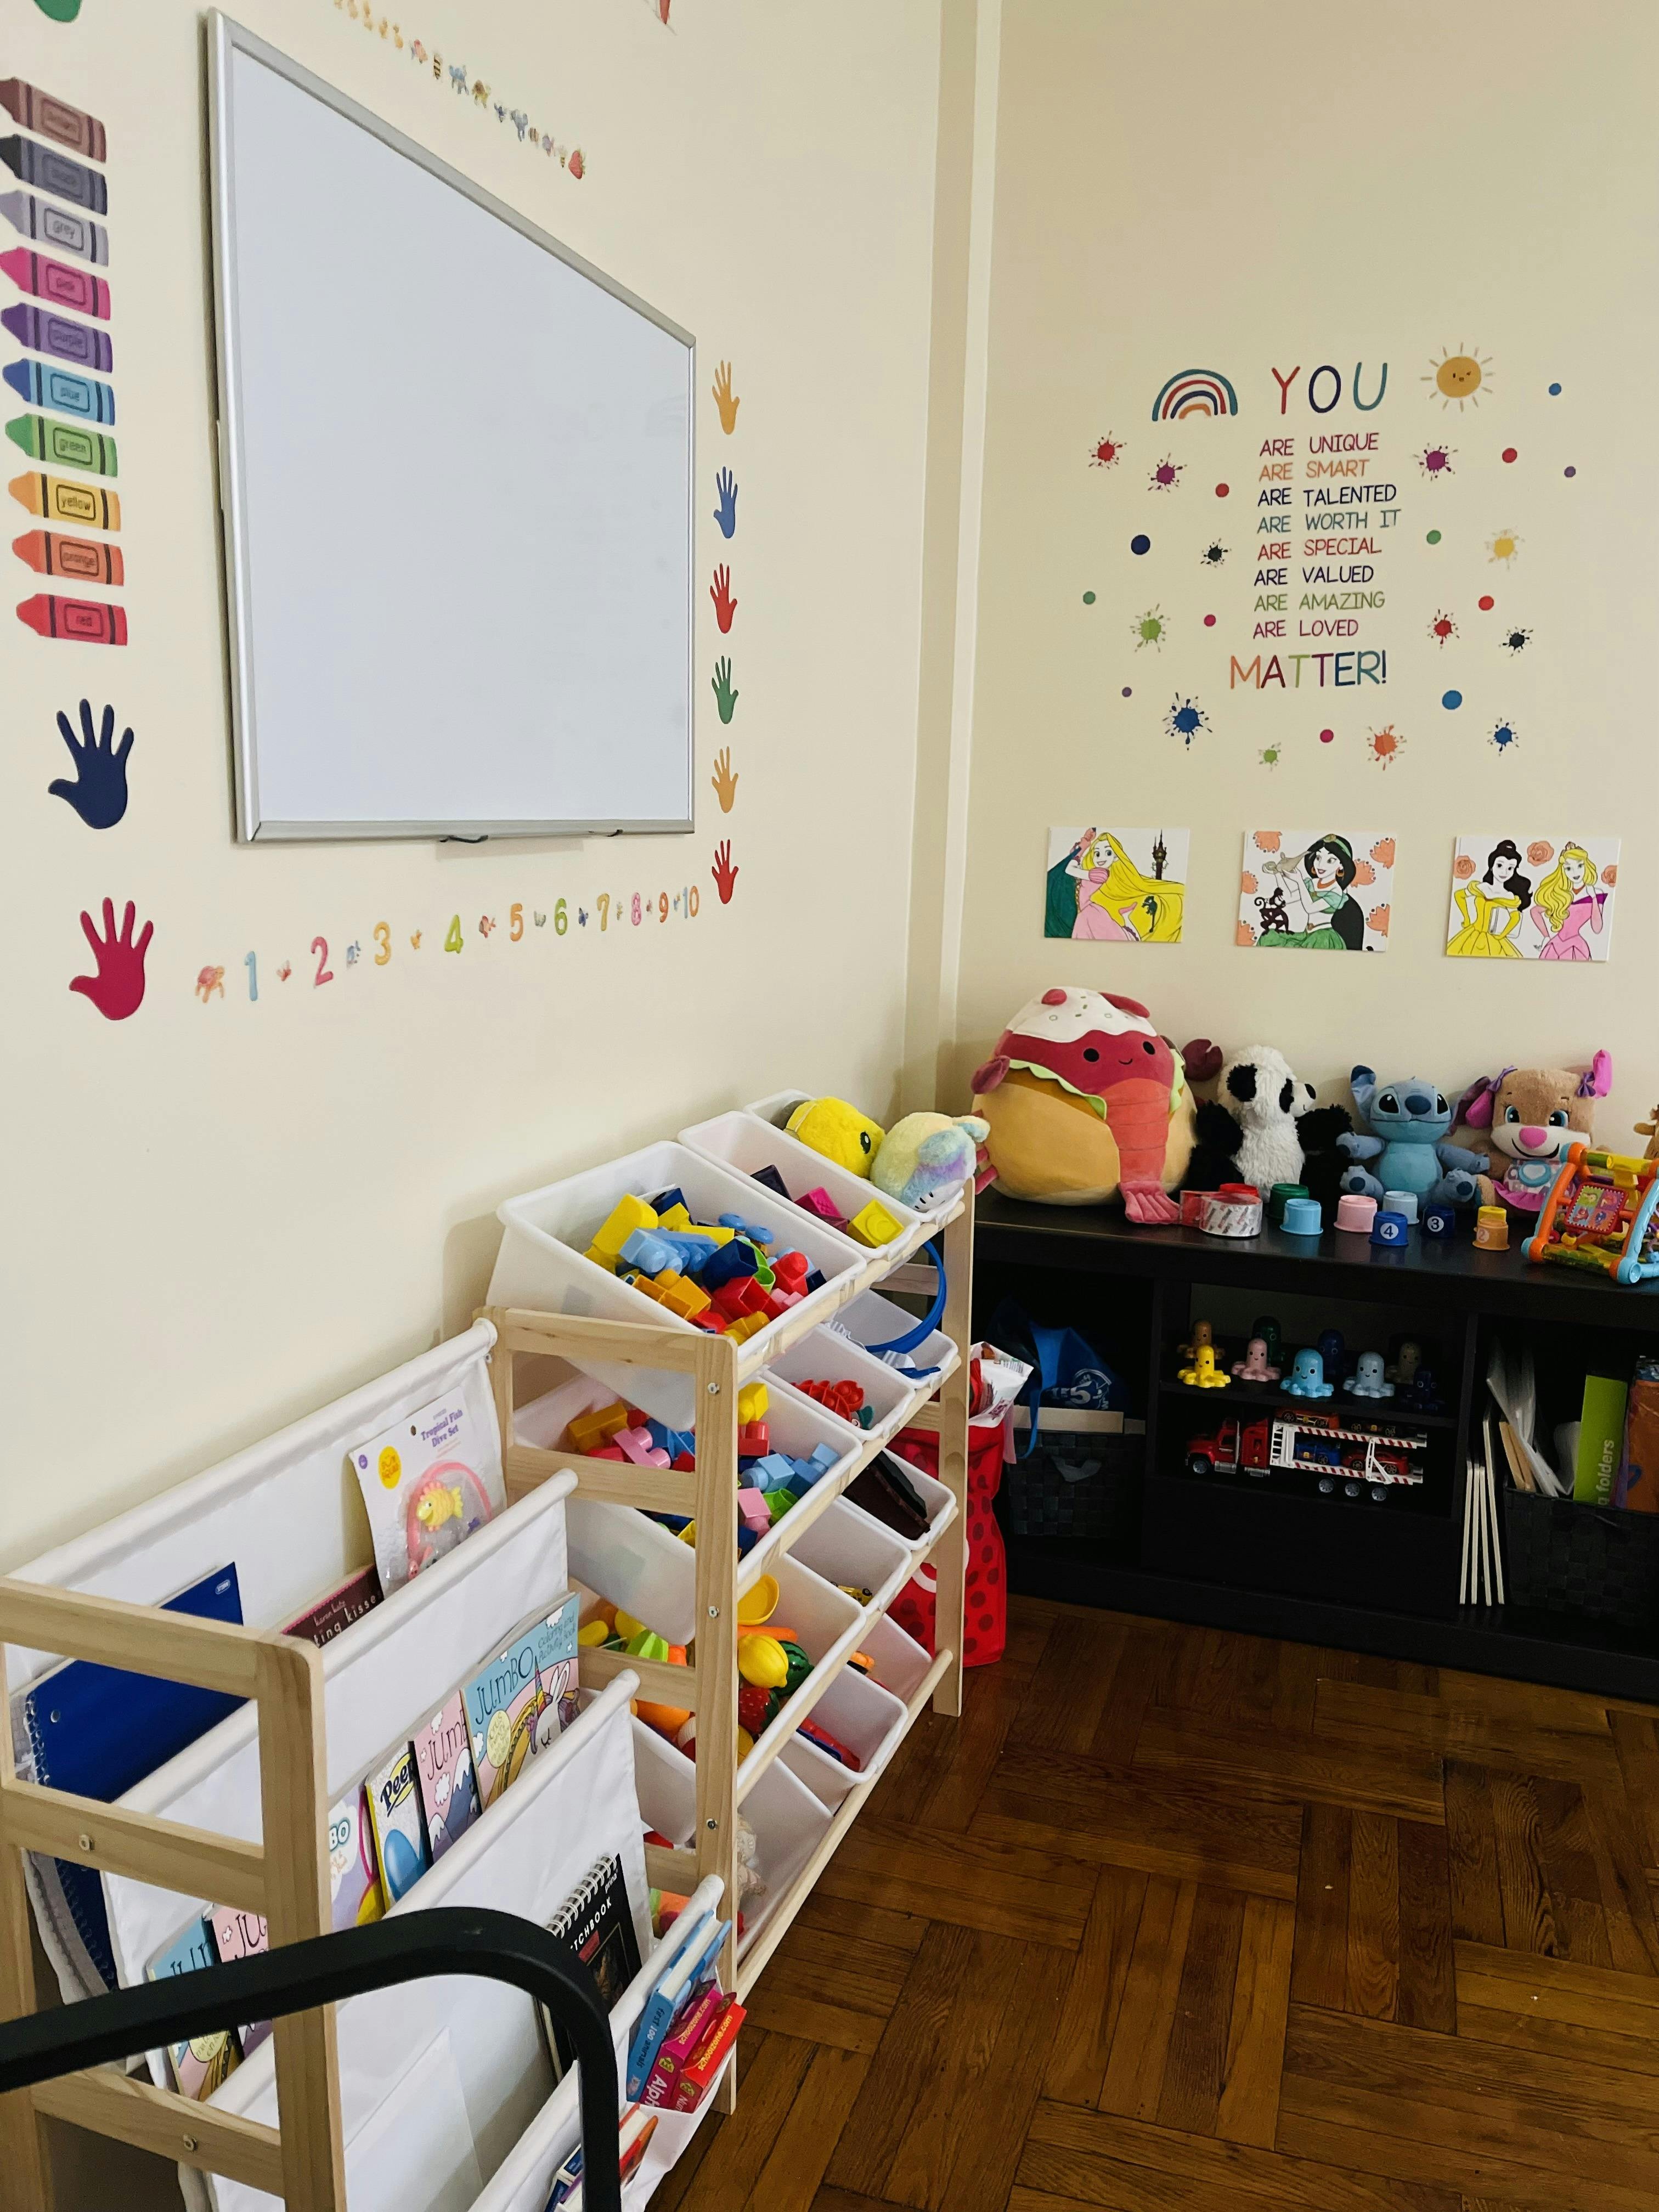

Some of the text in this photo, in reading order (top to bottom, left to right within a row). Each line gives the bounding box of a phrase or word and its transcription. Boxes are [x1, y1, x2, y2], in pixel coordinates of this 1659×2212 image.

[53, 218, 76, 239] grey
[1271, 362, 1387, 415] YOU
[1259, 433, 1379, 456] ARE UNIQUE
[1259, 459, 1370, 482] ARE SMART
[61, 495, 92, 511] yellow
[1257, 484, 1396, 506] ARE TALENTED
[1257, 509, 1401, 533] ARE WORTH IT
[1257, 538, 1382, 561] ARE SPECIAL
[1254, 566, 1374, 585] ARE VALUED
[1254, 591, 1385, 611] ARE AMAZING
[1252, 619, 1358, 639] ARE LOVED
[1230, 650, 1387, 689] MATTER!
[244, 885, 699, 1002] 1 2 3 4 5 6 7 8 9 10
[1384, 1226, 1393, 1237] 4
[1431, 1218, 1439, 1230] 3
[1479, 1230, 1485, 1241] 2
[420, 1417, 449, 1441] Tropical
[449, 1409, 463, 1424] Fish
[431, 1424, 459, 1447] Dive Set
[1597, 1439, 1615, 1492] folders
[344, 1593, 380, 1623] kisse
[570, 1897, 612, 1951] TCHBOOK
[647, 2025, 657, 2041] 100
[679, 1999, 712, 2045] schoolzone.com
[636, 2040, 652, 2068] animals
[697, 2015, 733, 2072] schoolzone.com
